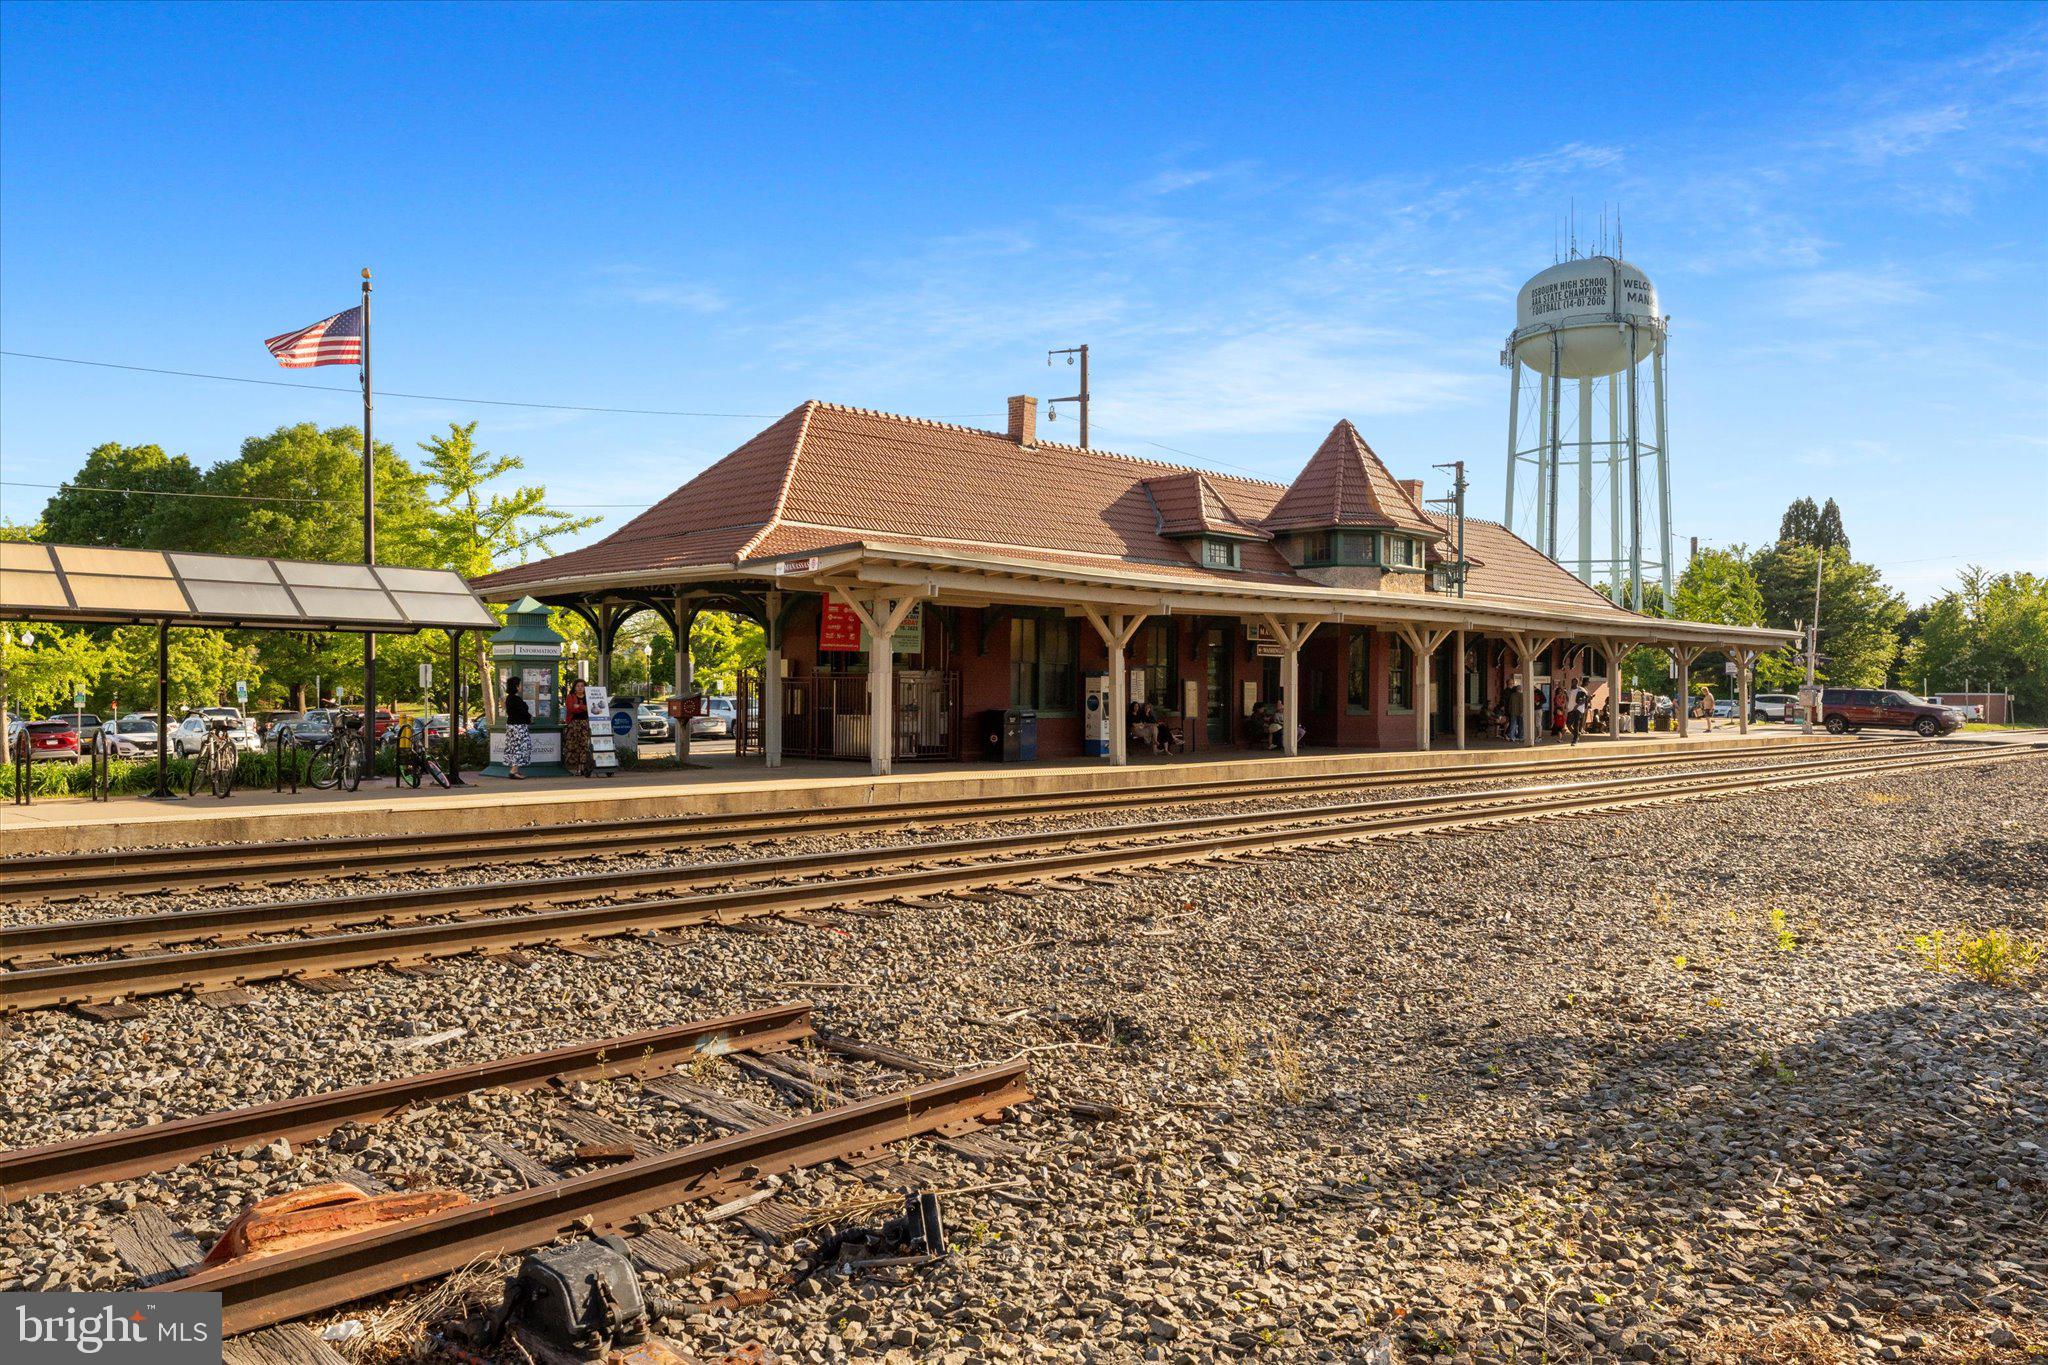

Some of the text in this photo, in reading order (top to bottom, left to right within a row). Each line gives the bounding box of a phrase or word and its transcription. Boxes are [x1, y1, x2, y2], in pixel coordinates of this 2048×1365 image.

[1560, 279, 1578, 290] HIGH
[1579, 277, 1608, 288] SCHOOL
[1543, 292, 1562, 304] STATE
[1564, 286, 1607, 300] CHAMPIONS
[1532, 296, 1606, 316] FOOTBALL (14-0) 2006
